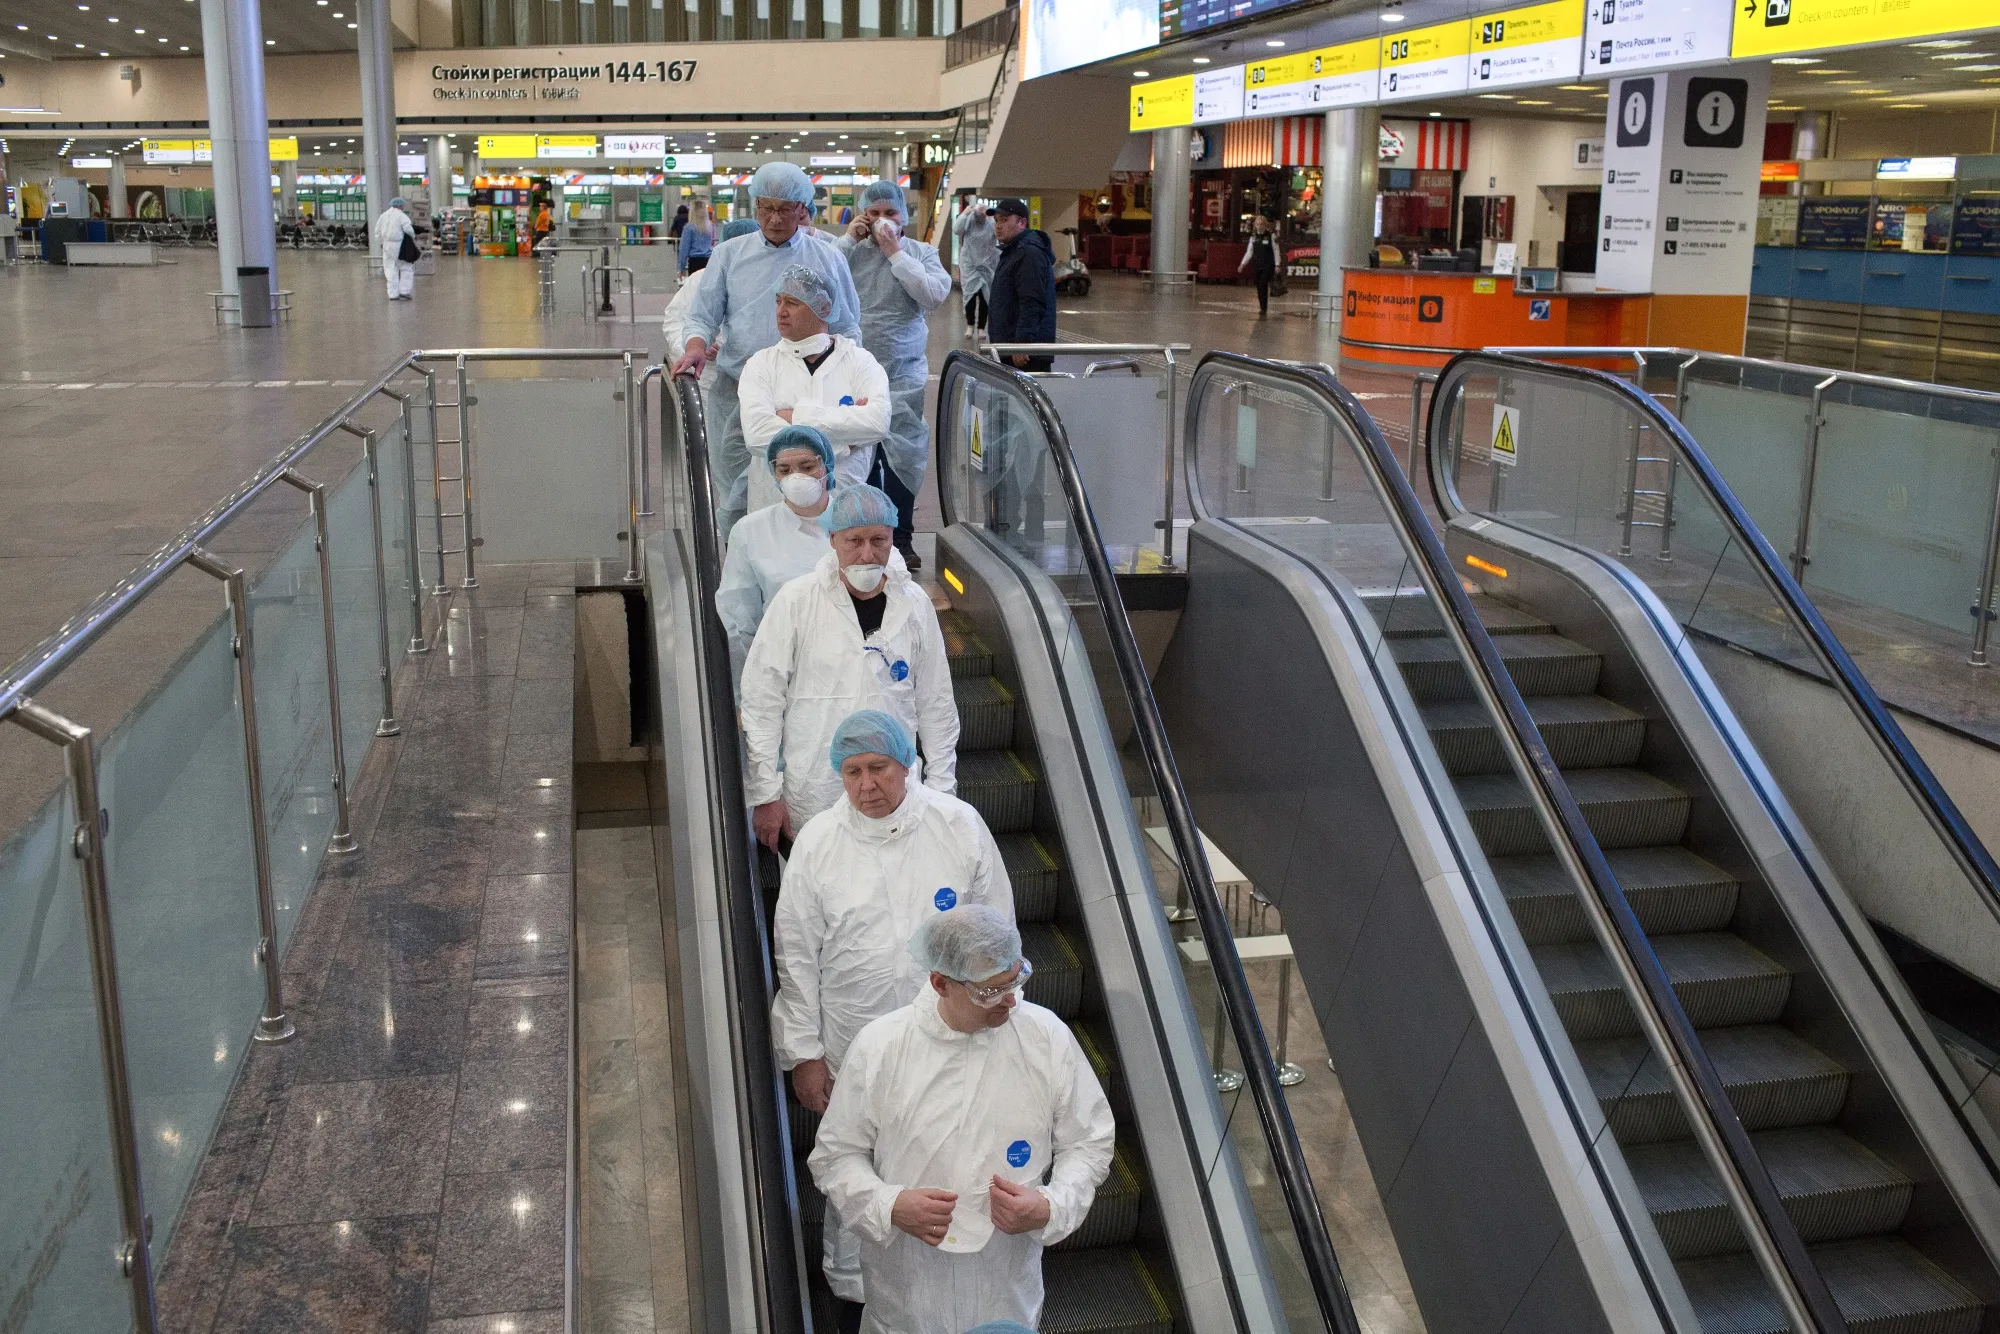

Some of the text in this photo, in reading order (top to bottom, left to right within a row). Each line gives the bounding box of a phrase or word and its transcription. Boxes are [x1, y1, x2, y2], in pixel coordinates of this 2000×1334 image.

[1798, 5, 1869, 24] Check-in counters
[432, 60, 698, 83] Стойки регистрации 144-167
[433, 87, 528, 99] Check-in counters
[1286, 265, 1320, 277] FRID
